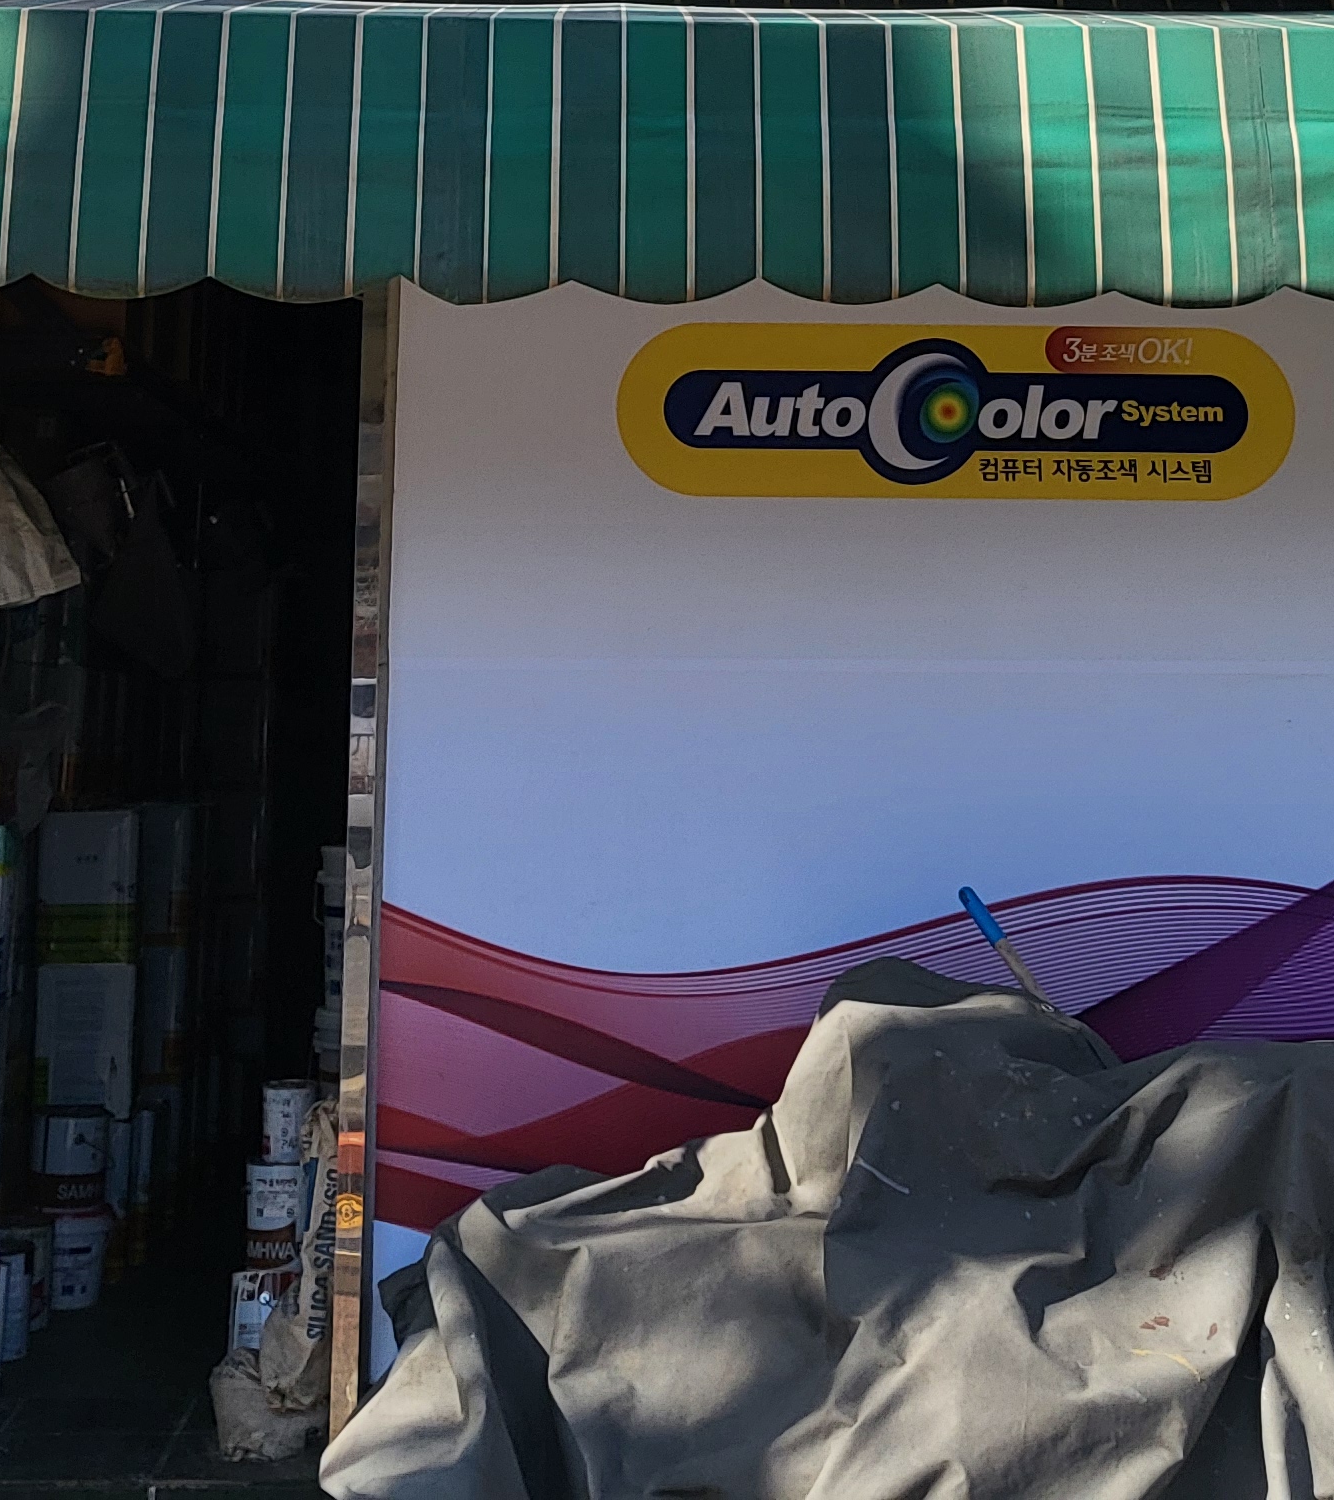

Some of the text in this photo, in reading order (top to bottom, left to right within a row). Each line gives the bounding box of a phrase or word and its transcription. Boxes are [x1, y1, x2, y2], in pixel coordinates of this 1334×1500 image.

[1121, 400, 1224, 427] System
[978, 457, 1213, 484] 컴퓨터 자동조색 시스템
